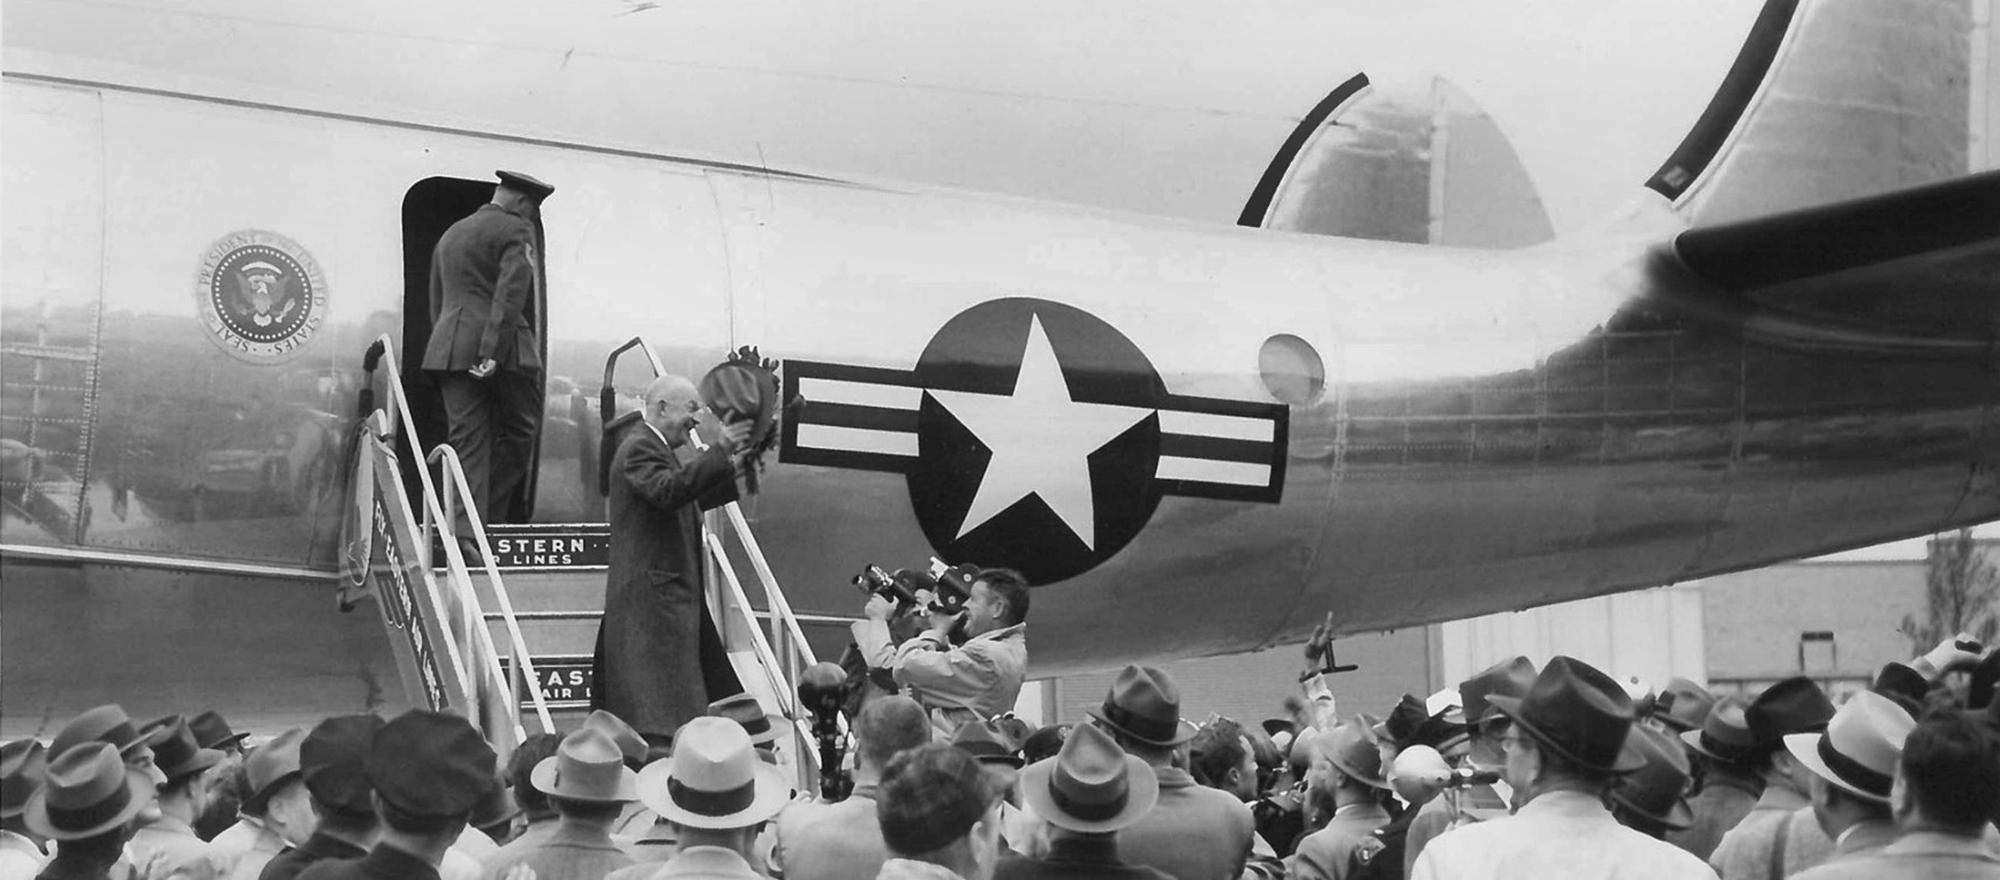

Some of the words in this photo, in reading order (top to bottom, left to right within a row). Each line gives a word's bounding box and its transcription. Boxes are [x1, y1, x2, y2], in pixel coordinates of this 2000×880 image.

[200, 235, 256, 286] PRESIDENT
[213, 322, 249, 353] SEAL
[274, 317, 321, 354] STATES
[498, 538, 585, 553] STERN
[513, 554, 572, 565] LINES
[542, 688, 572, 699] AIR
